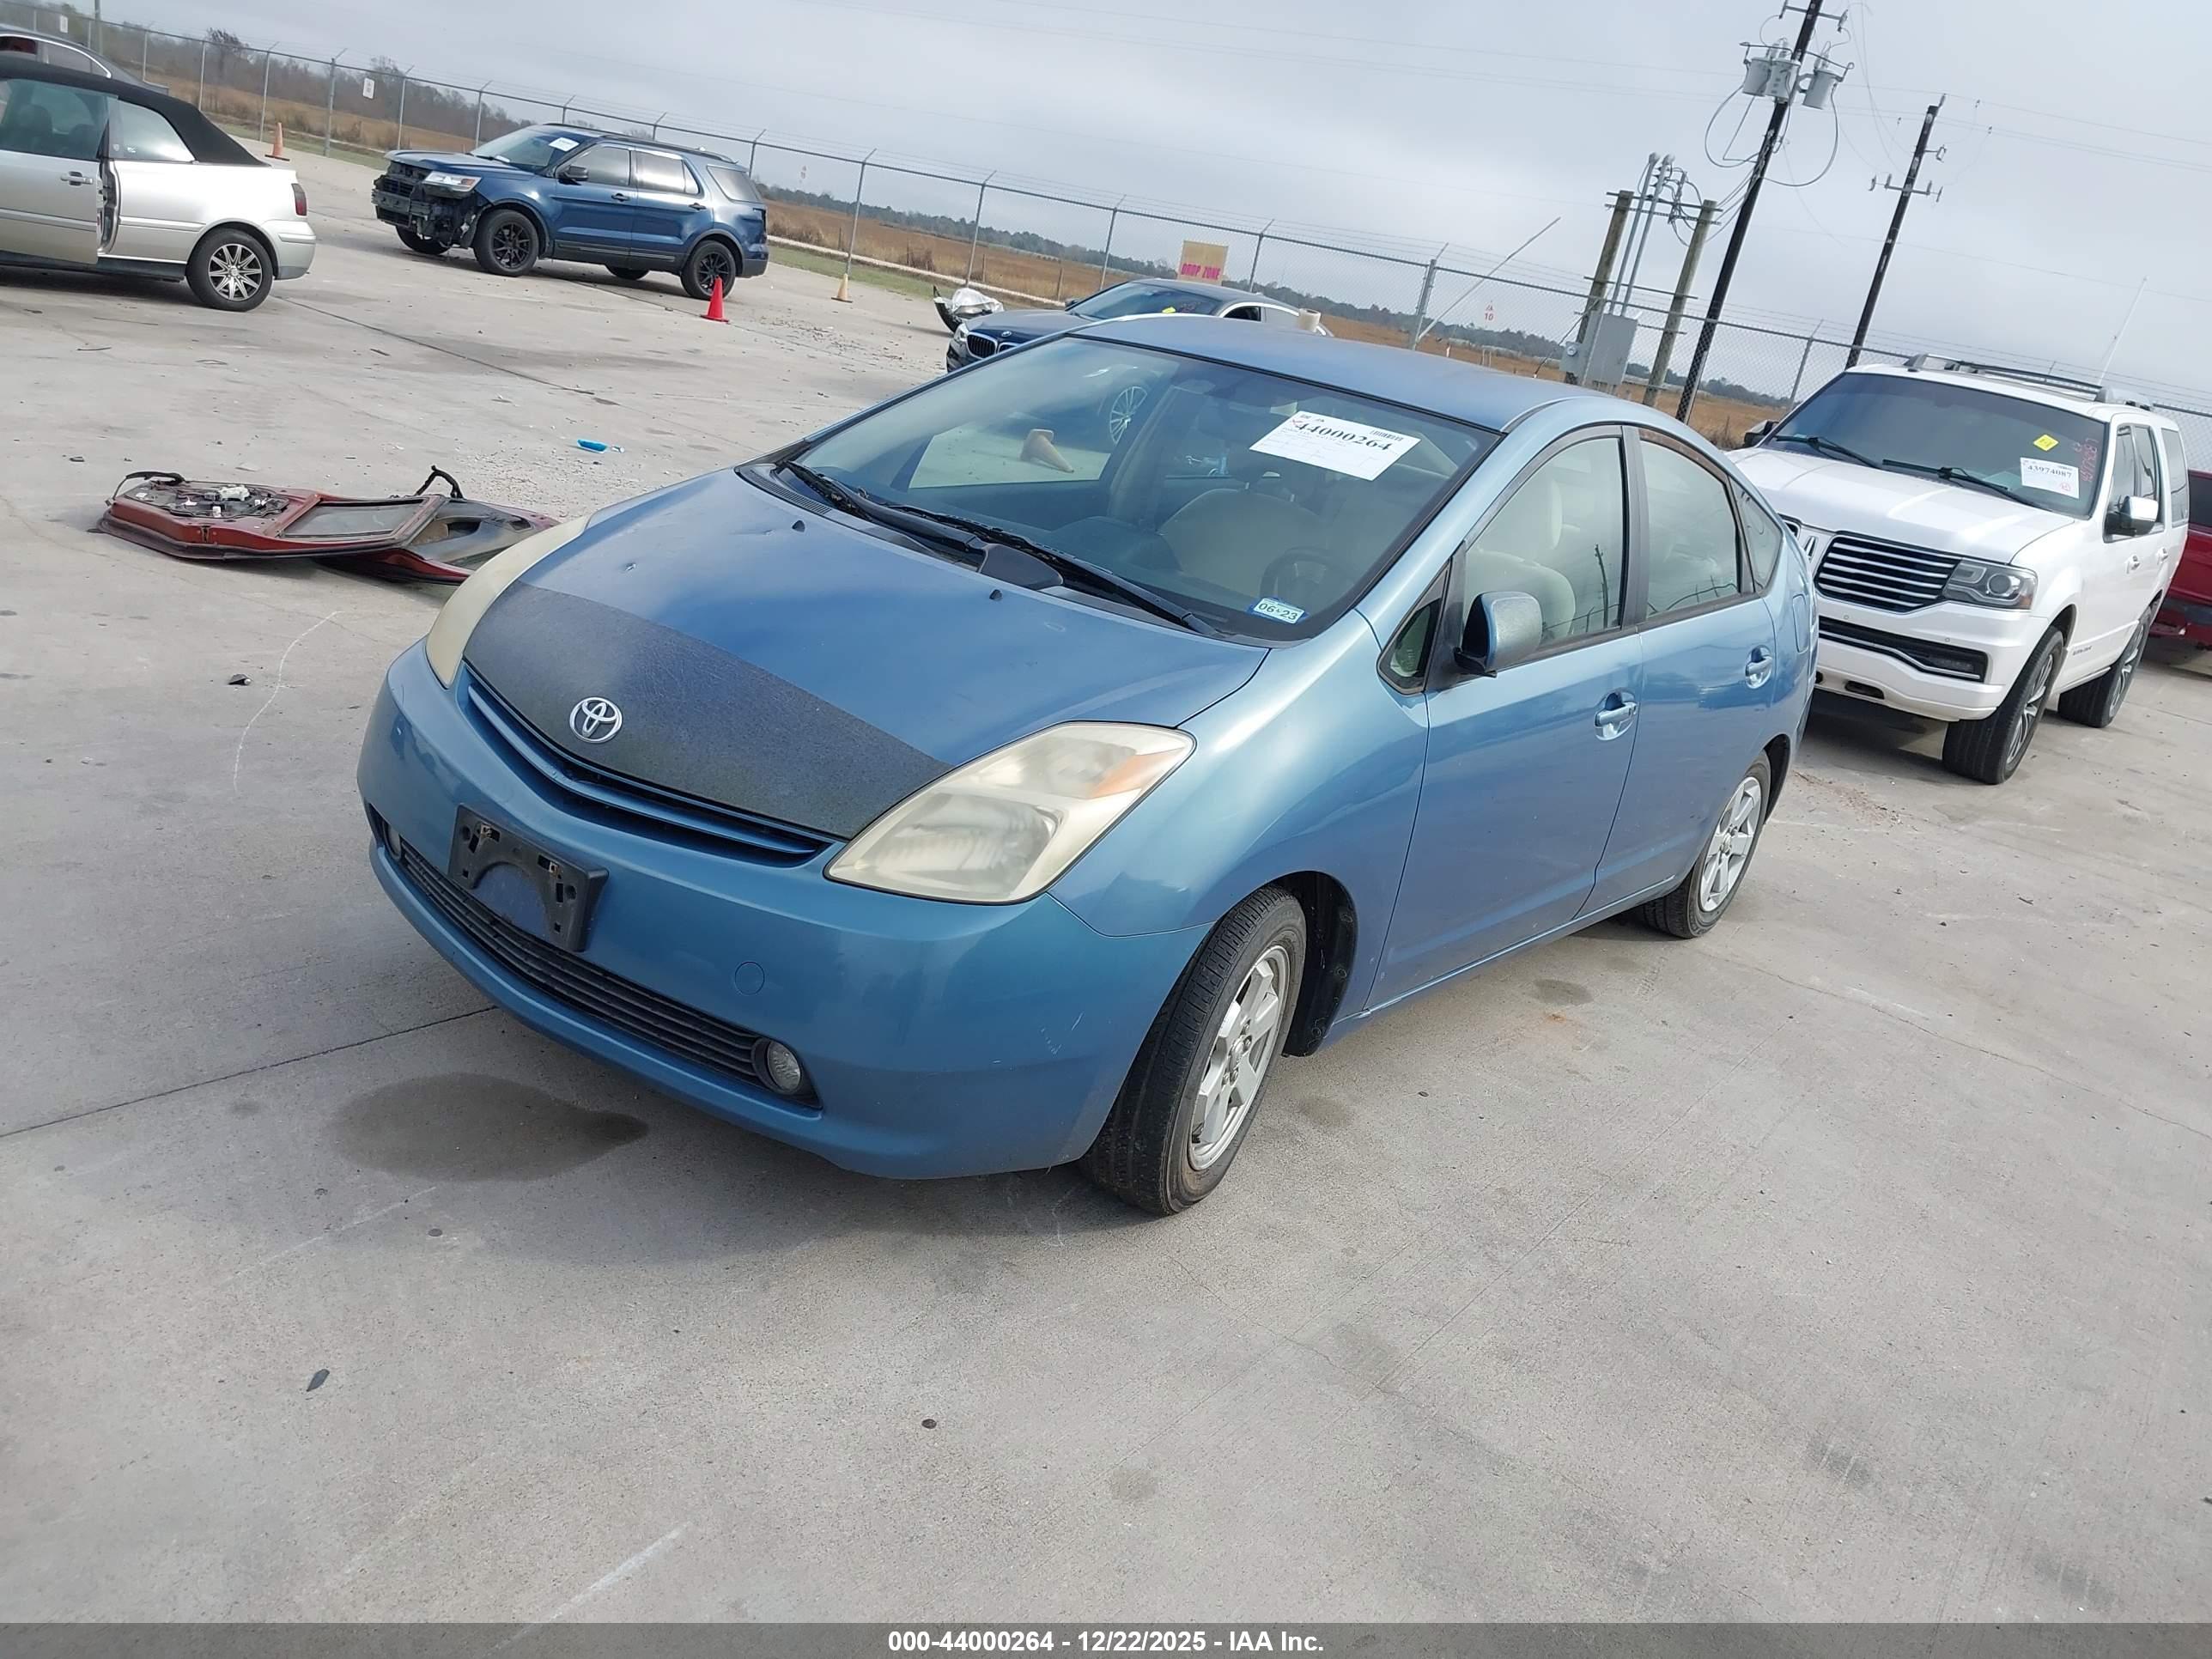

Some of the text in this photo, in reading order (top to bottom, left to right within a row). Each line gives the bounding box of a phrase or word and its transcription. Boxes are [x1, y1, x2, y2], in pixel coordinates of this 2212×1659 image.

[1182, 263, 1220, 280] DROP ZONE
[1294, 422, 1392, 452] 44000264
[2027, 465, 2072, 478] 43974087
[1258, 603, 1297, 620] 06 23
